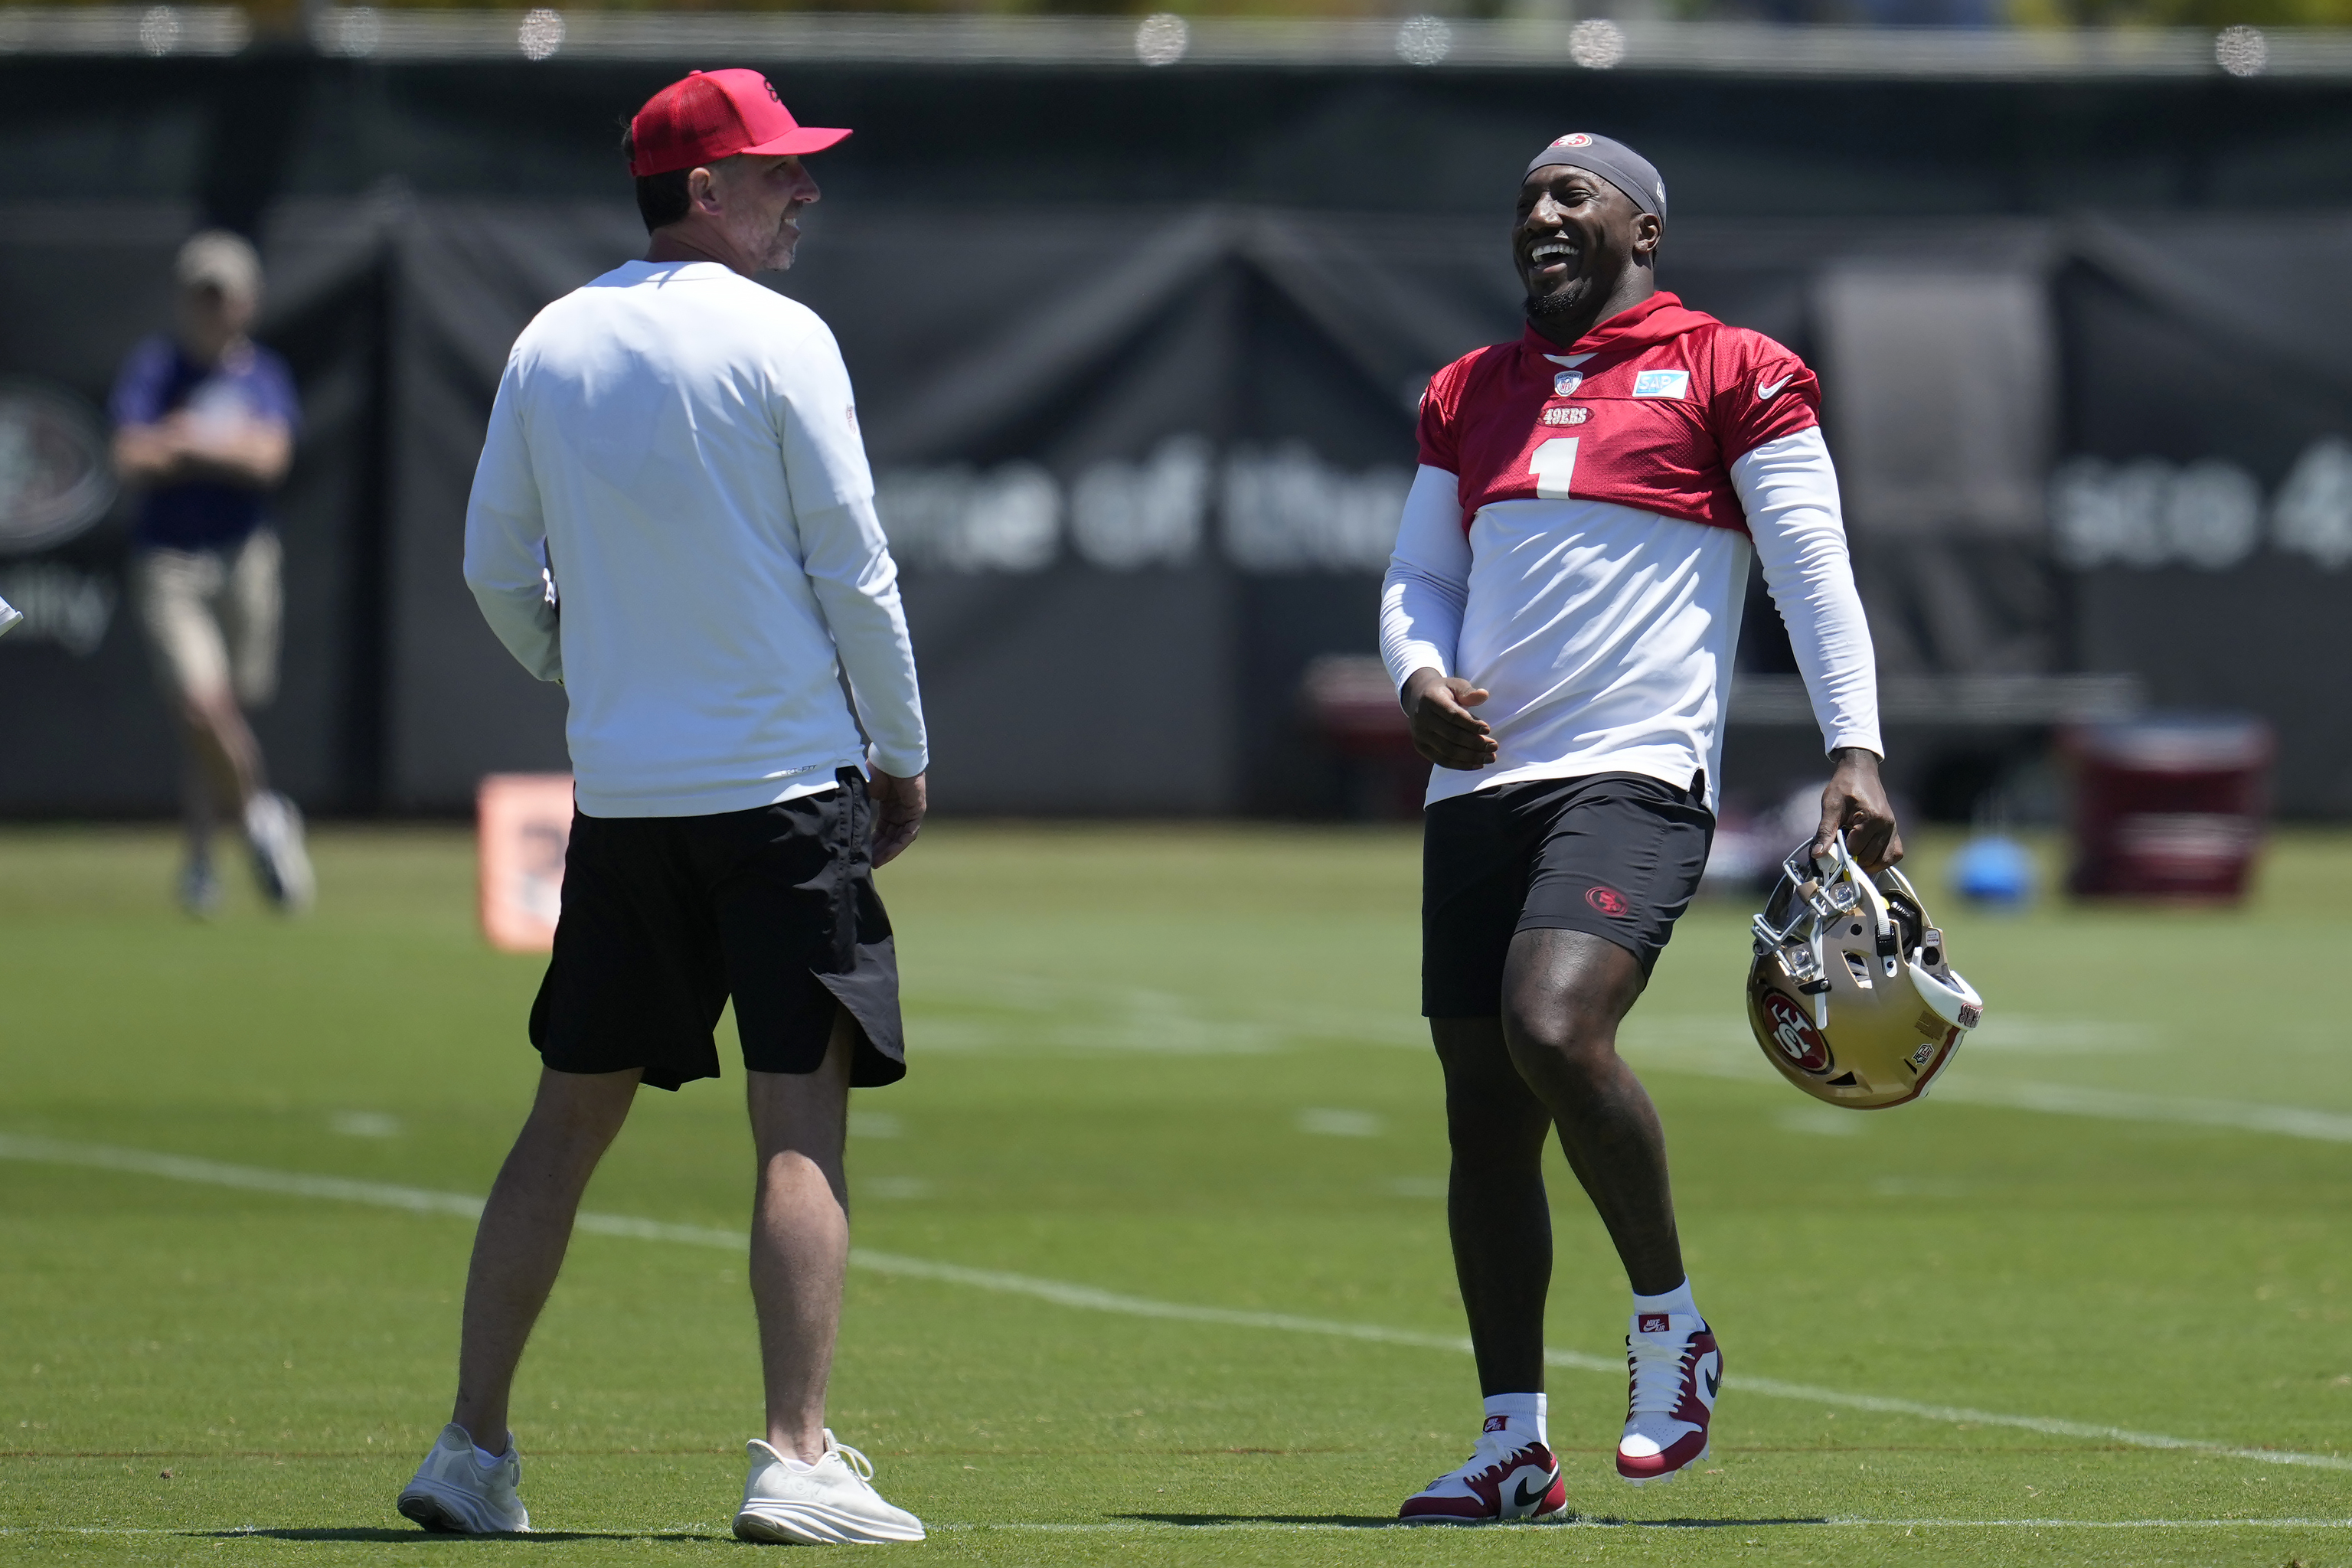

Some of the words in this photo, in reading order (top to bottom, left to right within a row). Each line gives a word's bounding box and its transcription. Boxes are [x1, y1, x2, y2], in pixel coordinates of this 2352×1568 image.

[1560, 382, 1573, 391] NFL
[1638, 375, 1672, 390] SAP
[1543, 407, 1587, 425] 49ERS
[1527, 436, 1579, 499] 1
[1918, 1046, 1932, 1058] NFL
[1646, 1318, 1661, 1327] NIKE
[773, 1471, 826, 1501] HOKA
